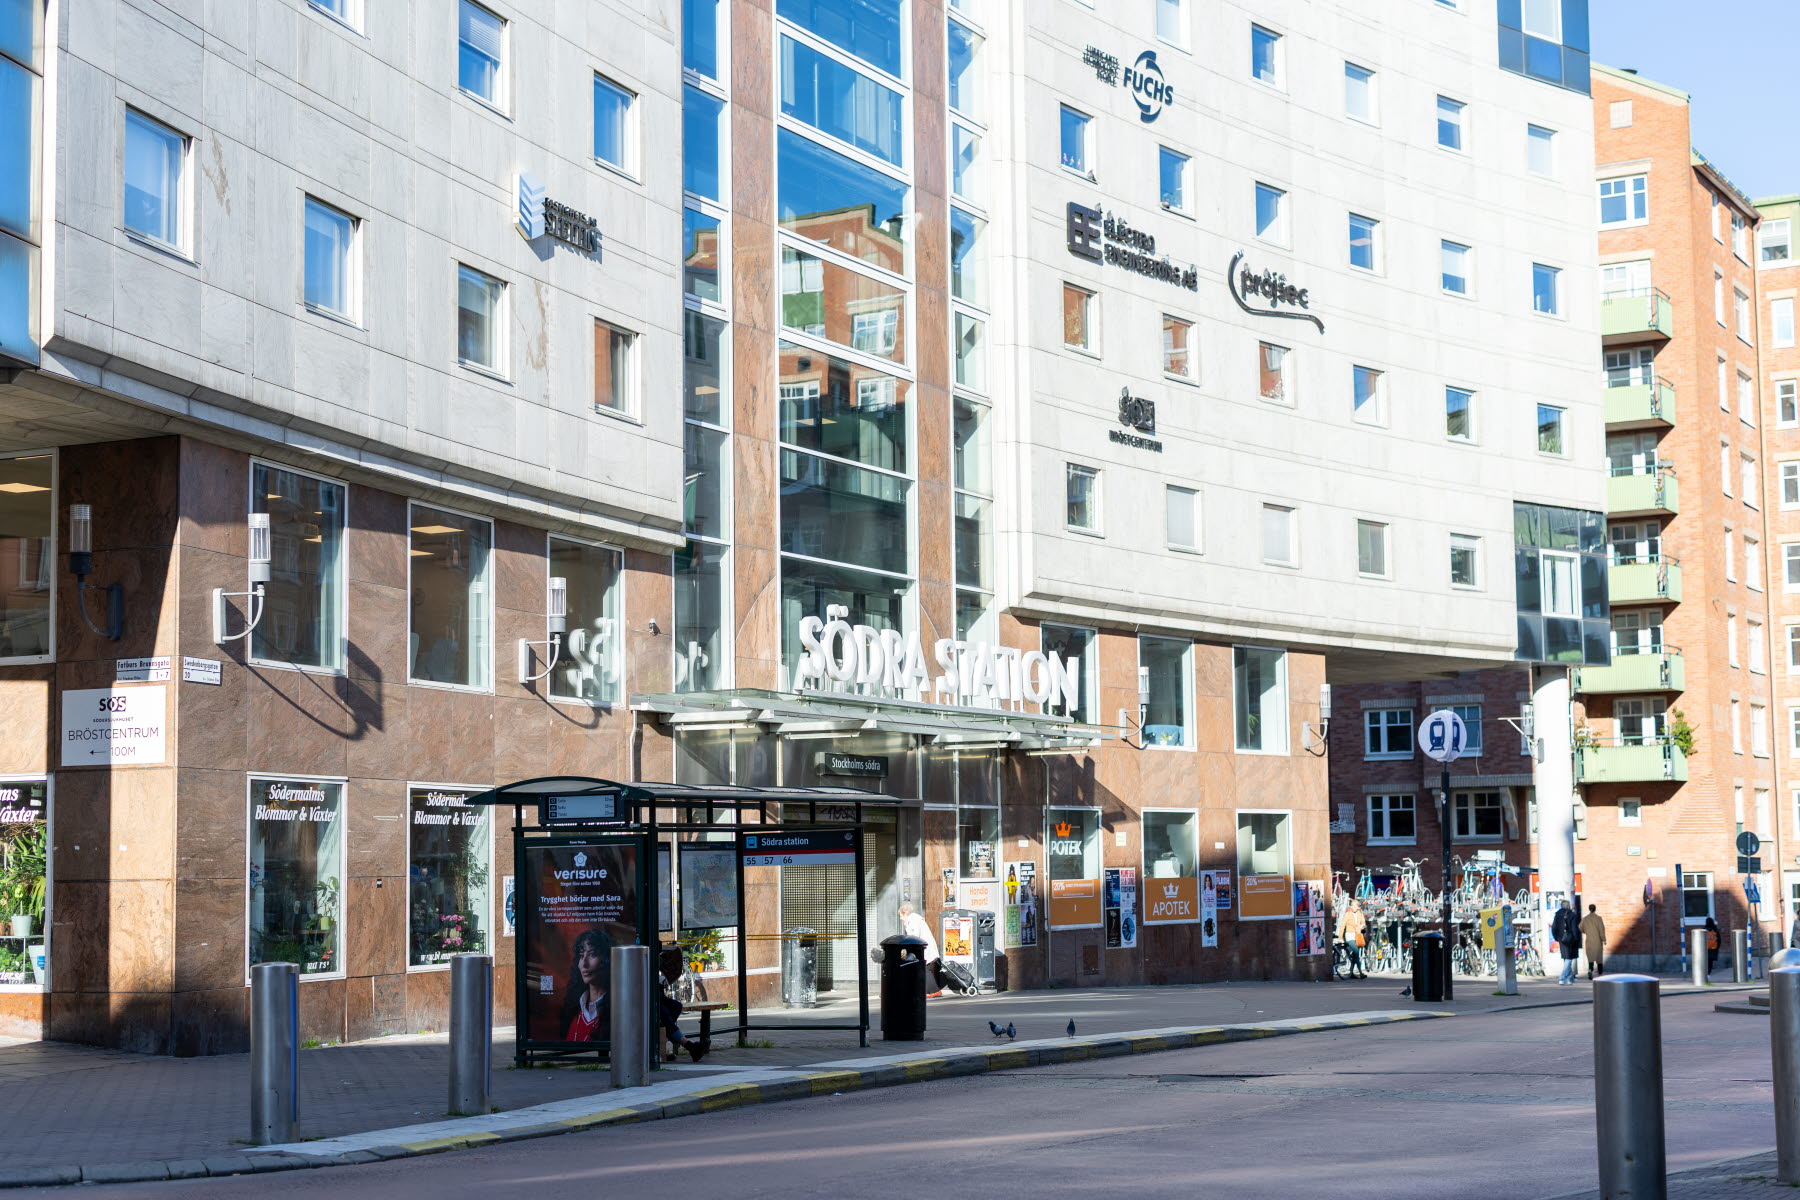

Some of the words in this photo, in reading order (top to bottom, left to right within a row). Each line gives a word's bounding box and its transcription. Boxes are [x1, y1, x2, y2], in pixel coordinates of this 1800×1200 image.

[1123, 67, 1173, 106] FUCHS
[1104, 244, 1180, 285] ENGINEERING
[1241, 271, 1308, 308] projsec
[799, 604, 931, 692] SÖDRA
[935, 638, 1079, 711] STATION
[99, 697, 126, 711] SÖS
[68, 727, 159, 741] BRÖSTCENTRUM
[110, 747, 136, 756] 100M
[831, 757, 864, 770] Stockholms
[865, 760, 881, 770] södra
[269, 784, 325, 802] Södermalms
[426, 792, 474, 807] Södermal
[255, 805, 298, 821] Blommor
[299, 806, 307, 821] &
[309, 806, 337, 822] Växter
[414, 811, 452, 825] Blommor
[452, 812, 460, 826] &
[461, 812, 486, 826] Växter
[784, 837, 809, 845] station
[1050, 840, 1083, 855] POTEK
[746, 857, 756, 865] 55
[764, 857, 774, 865] 57
[783, 856, 793, 864] 66
[554, 869, 607, 879] verisure
[970, 886, 989, 895] Handla
[1053, 881, 1066, 891] 20%
[540, 896, 568, 904] Trygghet
[569, 895, 589, 903] börjar
[1152, 901, 1190, 916] APOTEK
